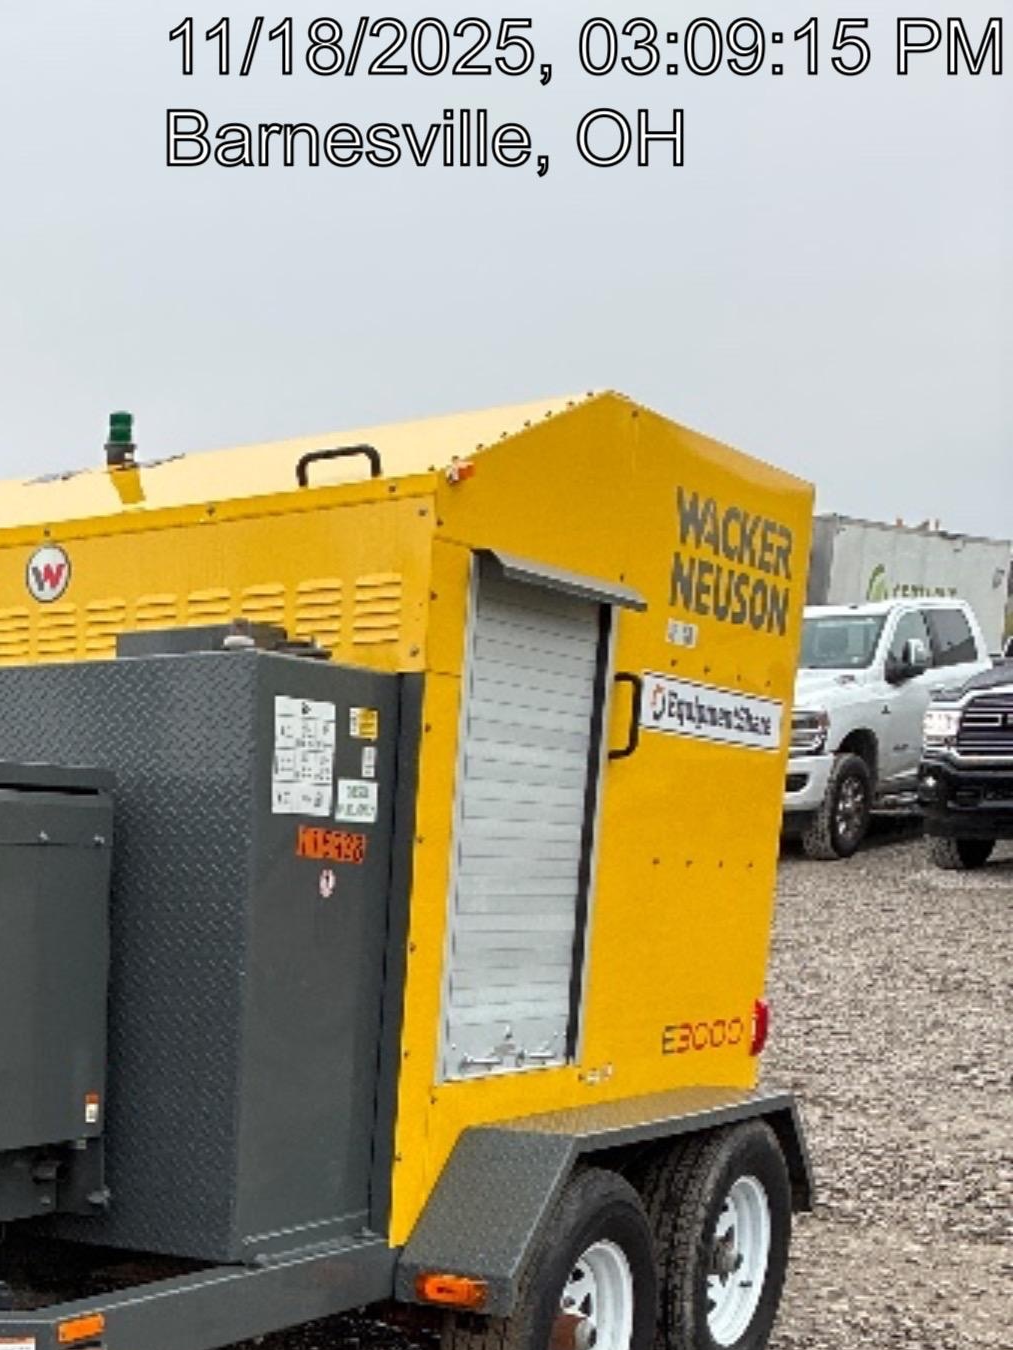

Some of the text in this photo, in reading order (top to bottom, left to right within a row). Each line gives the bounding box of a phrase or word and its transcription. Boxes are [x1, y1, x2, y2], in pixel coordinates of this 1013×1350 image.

[675, 485, 792, 580] WACKER
[31, 563, 66, 592] W
[669, 551, 790, 637] NEUSON
[662, 1017, 744, 1056] E3000
